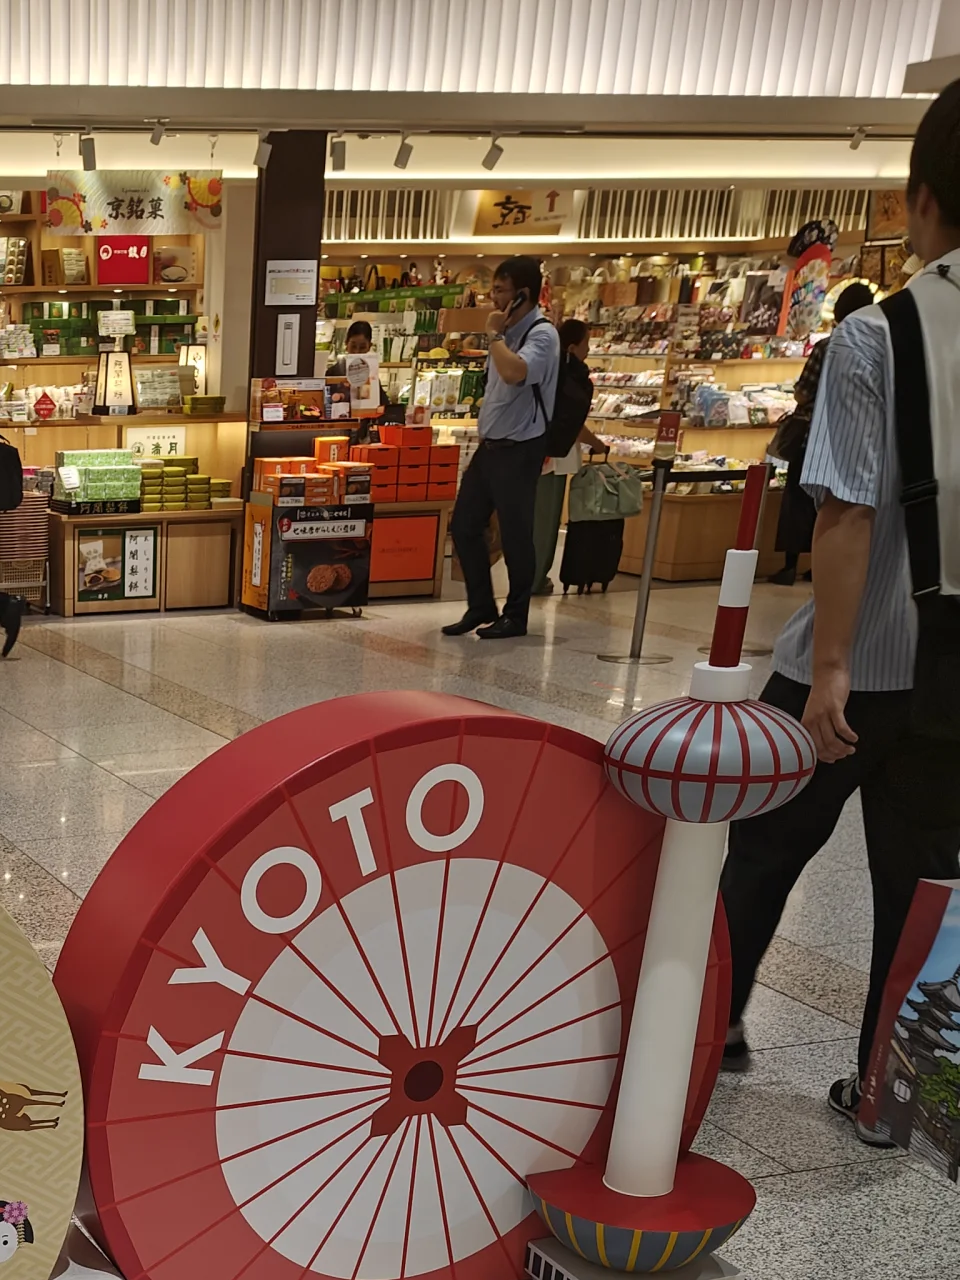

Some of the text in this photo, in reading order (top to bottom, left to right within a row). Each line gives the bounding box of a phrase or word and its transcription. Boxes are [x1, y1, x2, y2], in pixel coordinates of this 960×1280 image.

[106, 196, 165, 220] 京銘菓
[138, 763, 485, 1086] KYOTO
